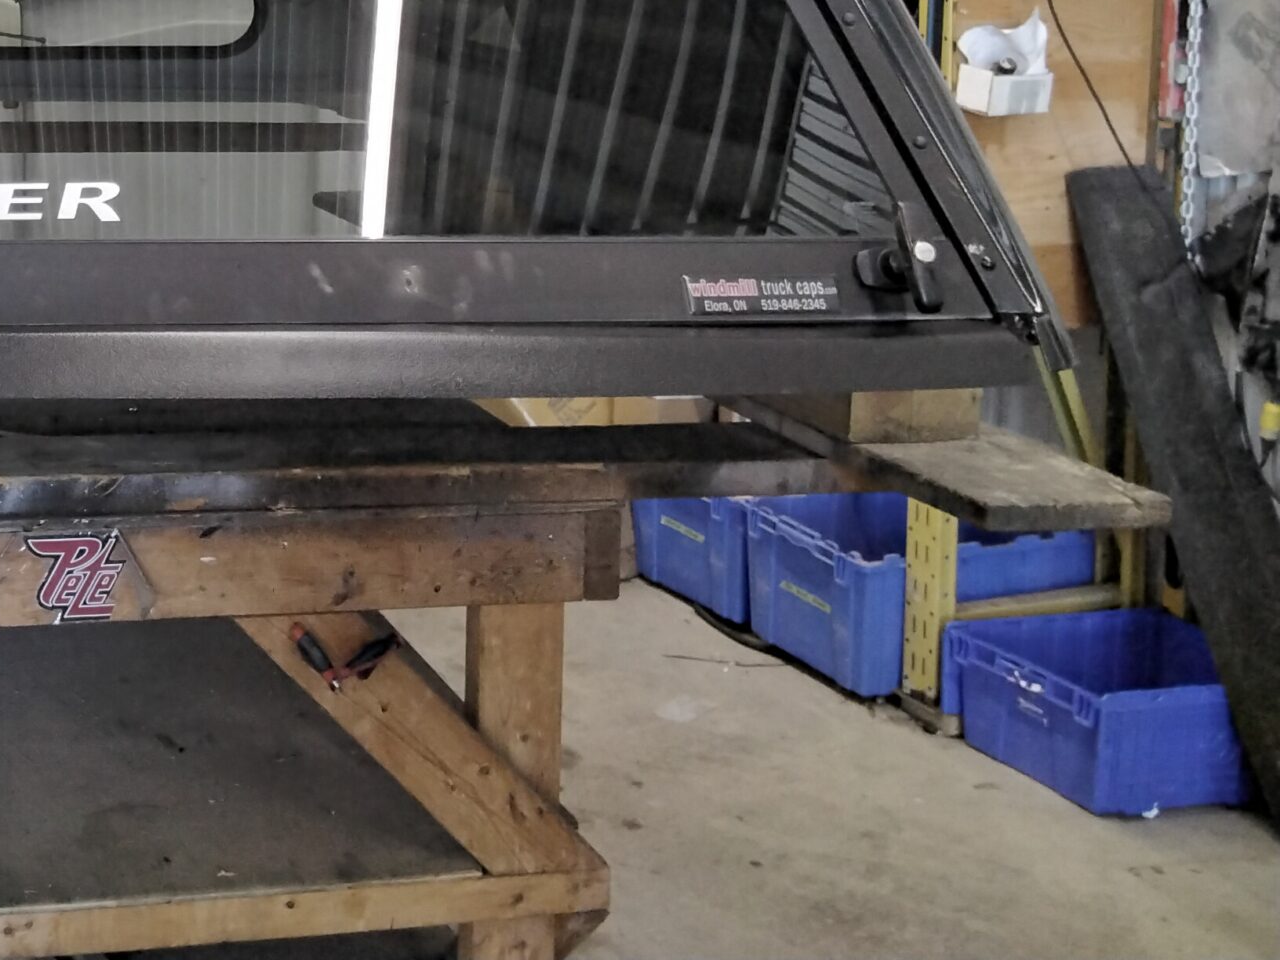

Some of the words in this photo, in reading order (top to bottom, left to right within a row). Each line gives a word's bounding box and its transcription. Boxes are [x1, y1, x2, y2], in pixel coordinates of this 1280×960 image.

[688, 278, 758, 297] windmill
[760, 278, 794, 295] truck
[704, 300, 732, 312] Elora,
[733, 299, 747, 311] ON
[760, 298, 826, 311] 519-846-2345
